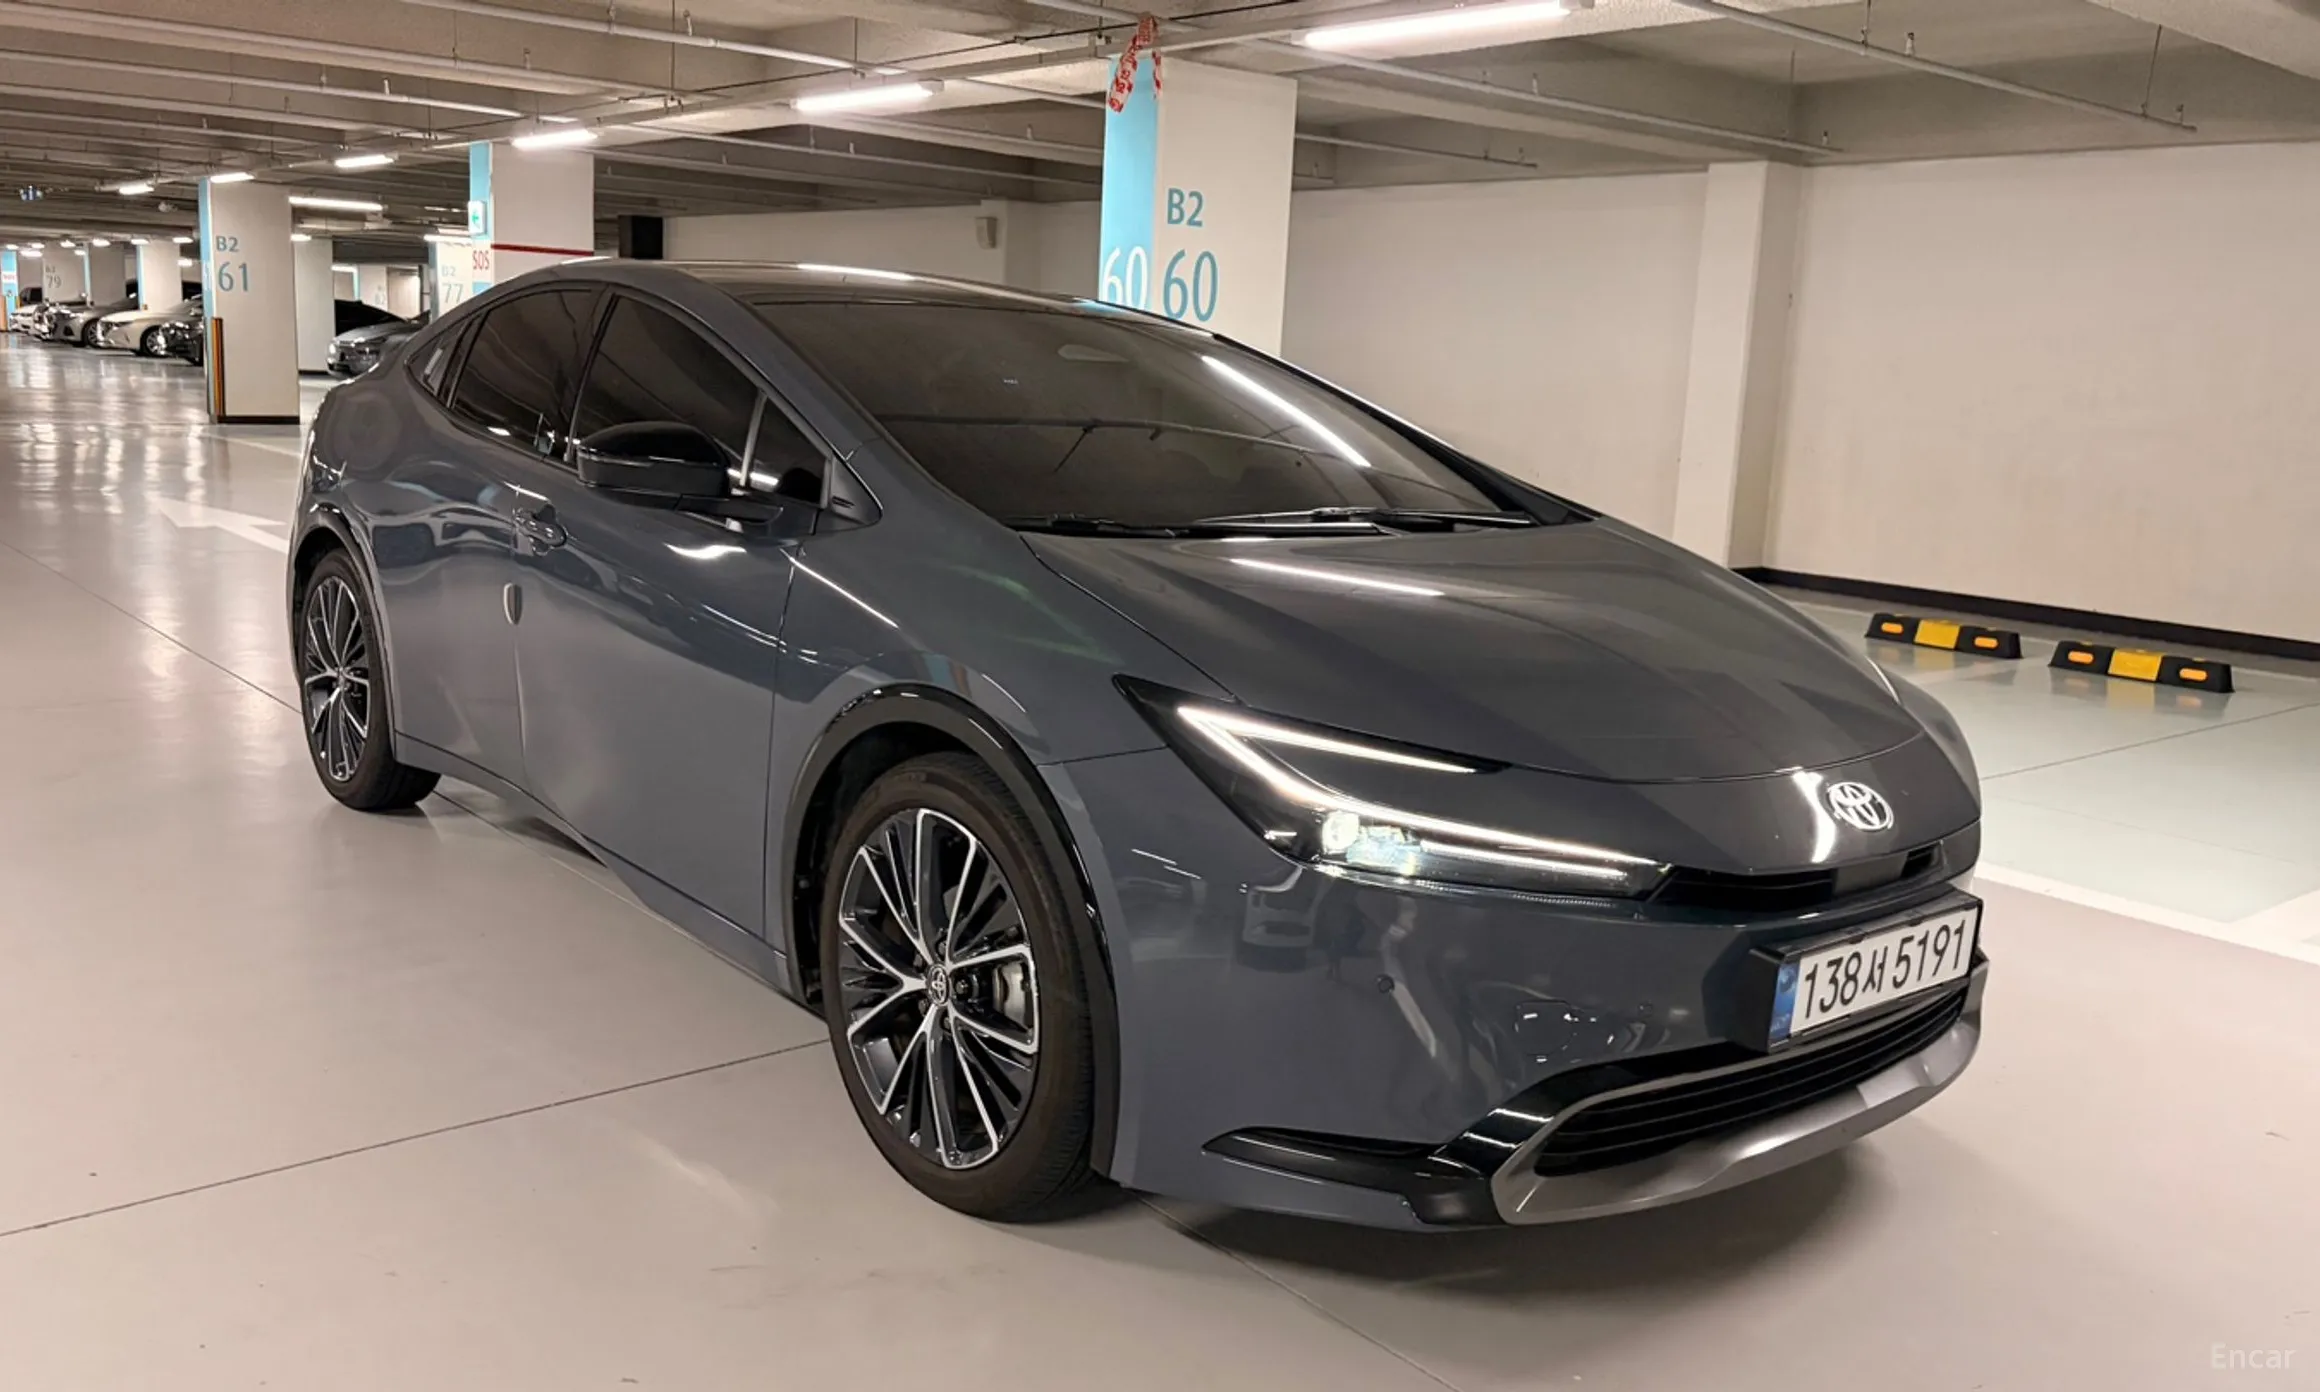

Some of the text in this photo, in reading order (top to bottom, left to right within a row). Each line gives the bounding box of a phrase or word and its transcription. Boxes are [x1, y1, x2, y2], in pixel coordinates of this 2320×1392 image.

[1166, 187, 1204, 227] B2
[216, 235, 239, 252] B2
[472, 250, 490, 270] SOS
[218, 261, 249, 292] 61
[1162, 249, 1218, 322] 60
[442, 283, 464, 304] 77
[1892, 918, 1966, 990] 5191
